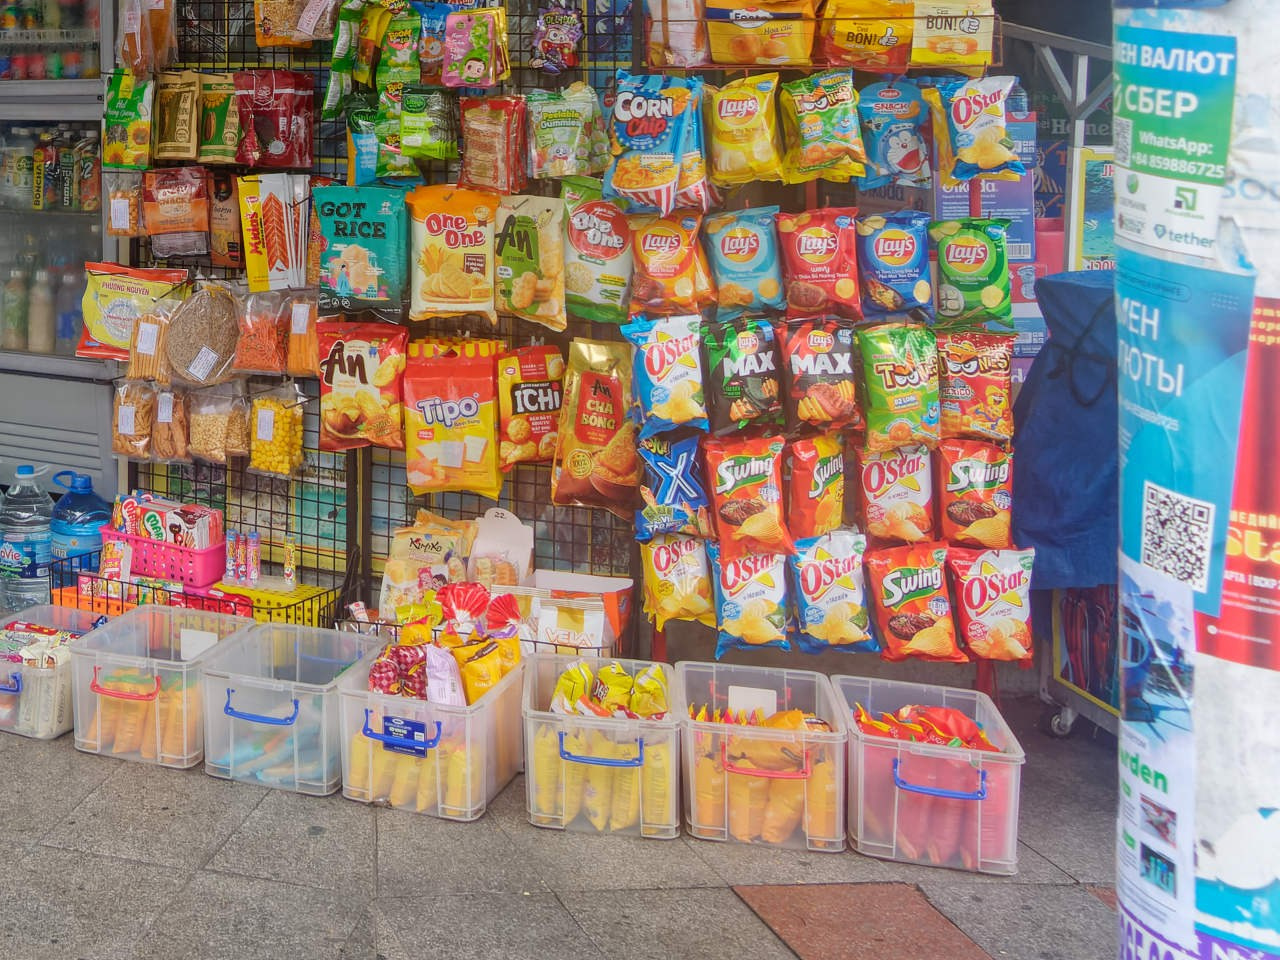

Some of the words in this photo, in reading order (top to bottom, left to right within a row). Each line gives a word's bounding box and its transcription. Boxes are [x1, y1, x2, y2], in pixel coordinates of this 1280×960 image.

[926, 14, 957, 32] BON!
[846, 31, 877, 46] BON!
[1141, 45, 1234, 76] ВАЛЮТ
[615, 91, 673, 122] CORN
[720, 98, 757, 117] Lay's
[873, 102, 908, 111] SNACK
[952, 87, 1004, 124] O'Star
[1125, 83, 1199, 119] СБЕР
[627, 117, 667, 137] Chip
[1139, 130, 1214, 155] WhatsApp:
[1149, 153, 1226, 178] 859886725
[33, 163, 44, 209] BONCHA
[942, 179, 997, 194] Oikda
[320, 200, 366, 220] GOT
[571, 211, 613, 233] One
[333, 220, 387, 239] RICE
[425, 213, 467, 235] One
[444, 229, 486, 249] One
[494, 215, 534, 260] An
[585, 228, 625, 249] One
[641, 231, 681, 256] Lay's
[722, 233, 758, 254] Lay's
[800, 233, 836, 255] Lay's
[877, 235, 913, 257] Lay's
[1168, 229, 1215, 249] tether
[946, 242, 987, 265] Lay's
[321, 340, 368, 386] An
[645, 332, 697, 378] O'Star
[723, 351, 776, 378] MAX
[790, 350, 855, 376] MAX
[717, 455, 775, 495] Swing
[808, 444, 845, 498] Swing
[863, 452, 921, 498] O'Star
[946, 455, 1010, 495] Swing
[799, 554, 858, 597] O'Star
[881, 566, 942, 608] Swing
[963, 569, 1027, 613] O'Star
